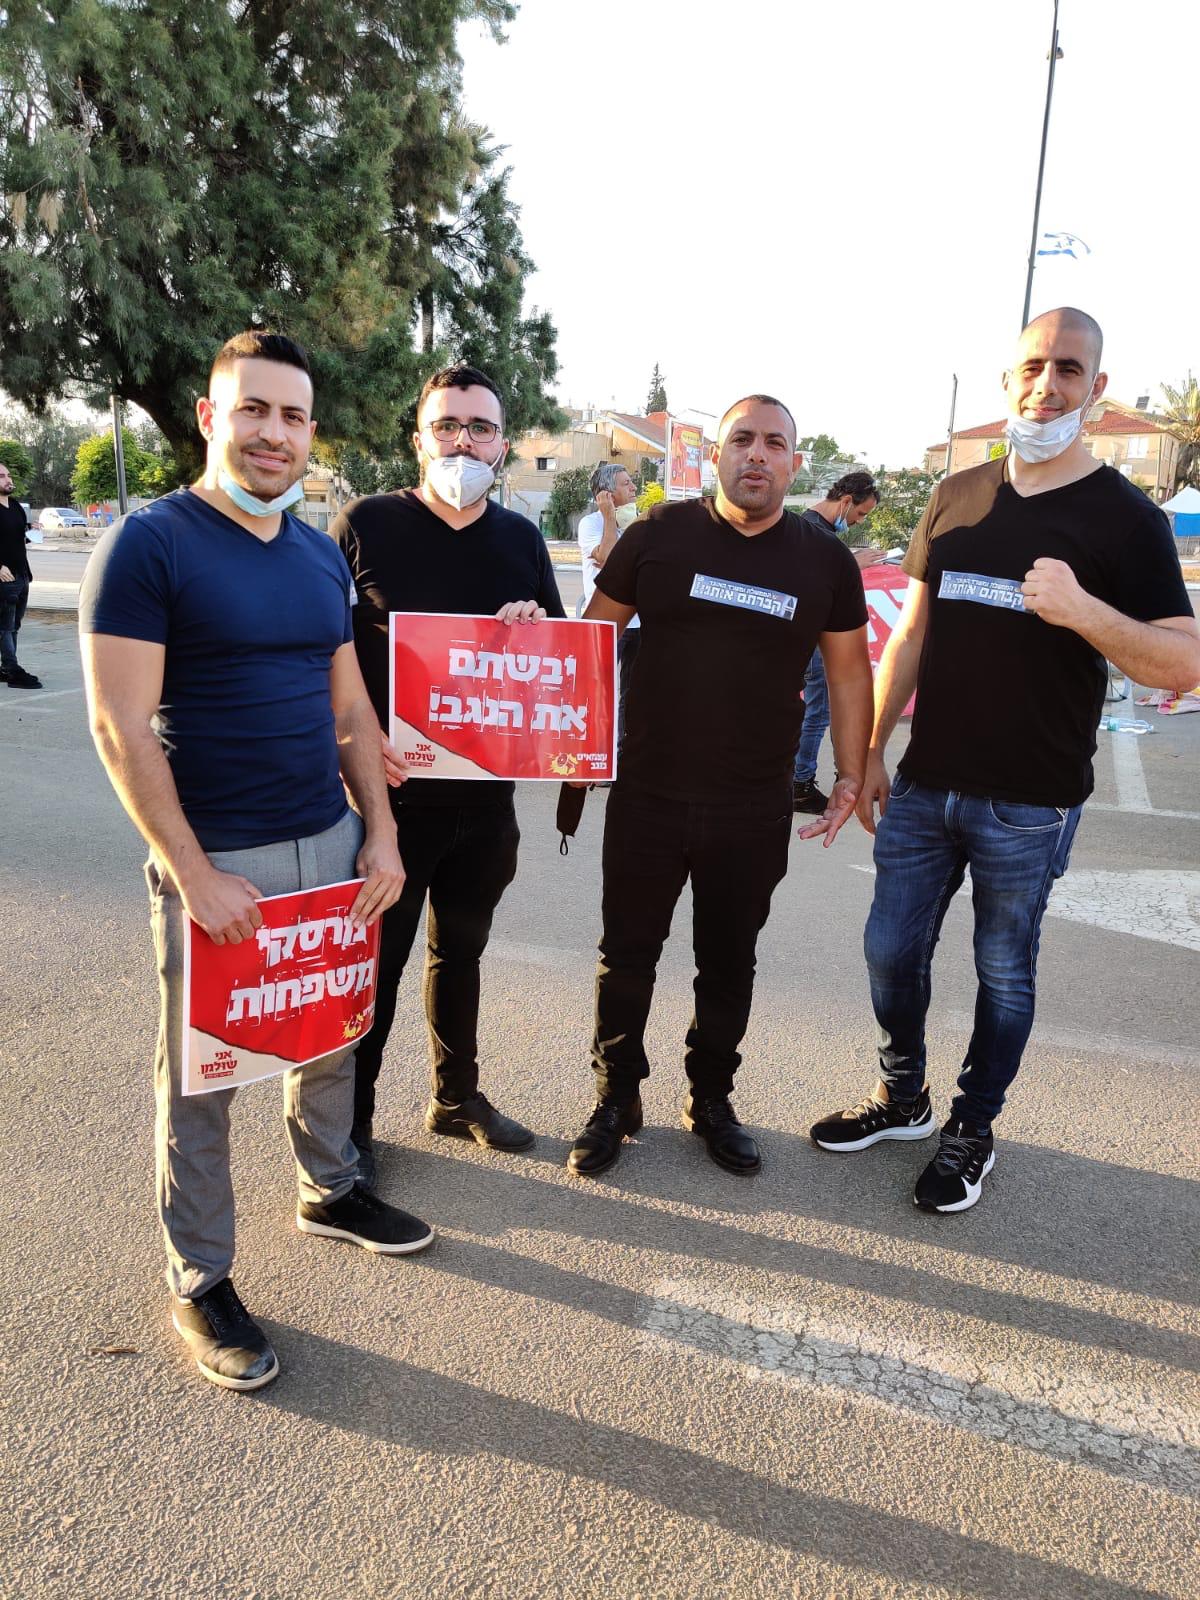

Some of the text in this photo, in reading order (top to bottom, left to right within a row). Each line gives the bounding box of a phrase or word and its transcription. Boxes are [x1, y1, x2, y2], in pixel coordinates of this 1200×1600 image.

[737, 593, 782, 615] קברתם
[979, 586, 1025, 608] קברתם
[449, 647, 577, 689] יבשתם
[429, 691, 587, 736] את הנגב!
[403, 751, 436, 762] שולמן
[415, 743, 432, 752] אני
[228, 957, 375, 1022] משפחות
[215, 1050, 232, 1060] אני
[200, 1060, 238, 1075] שולמן
